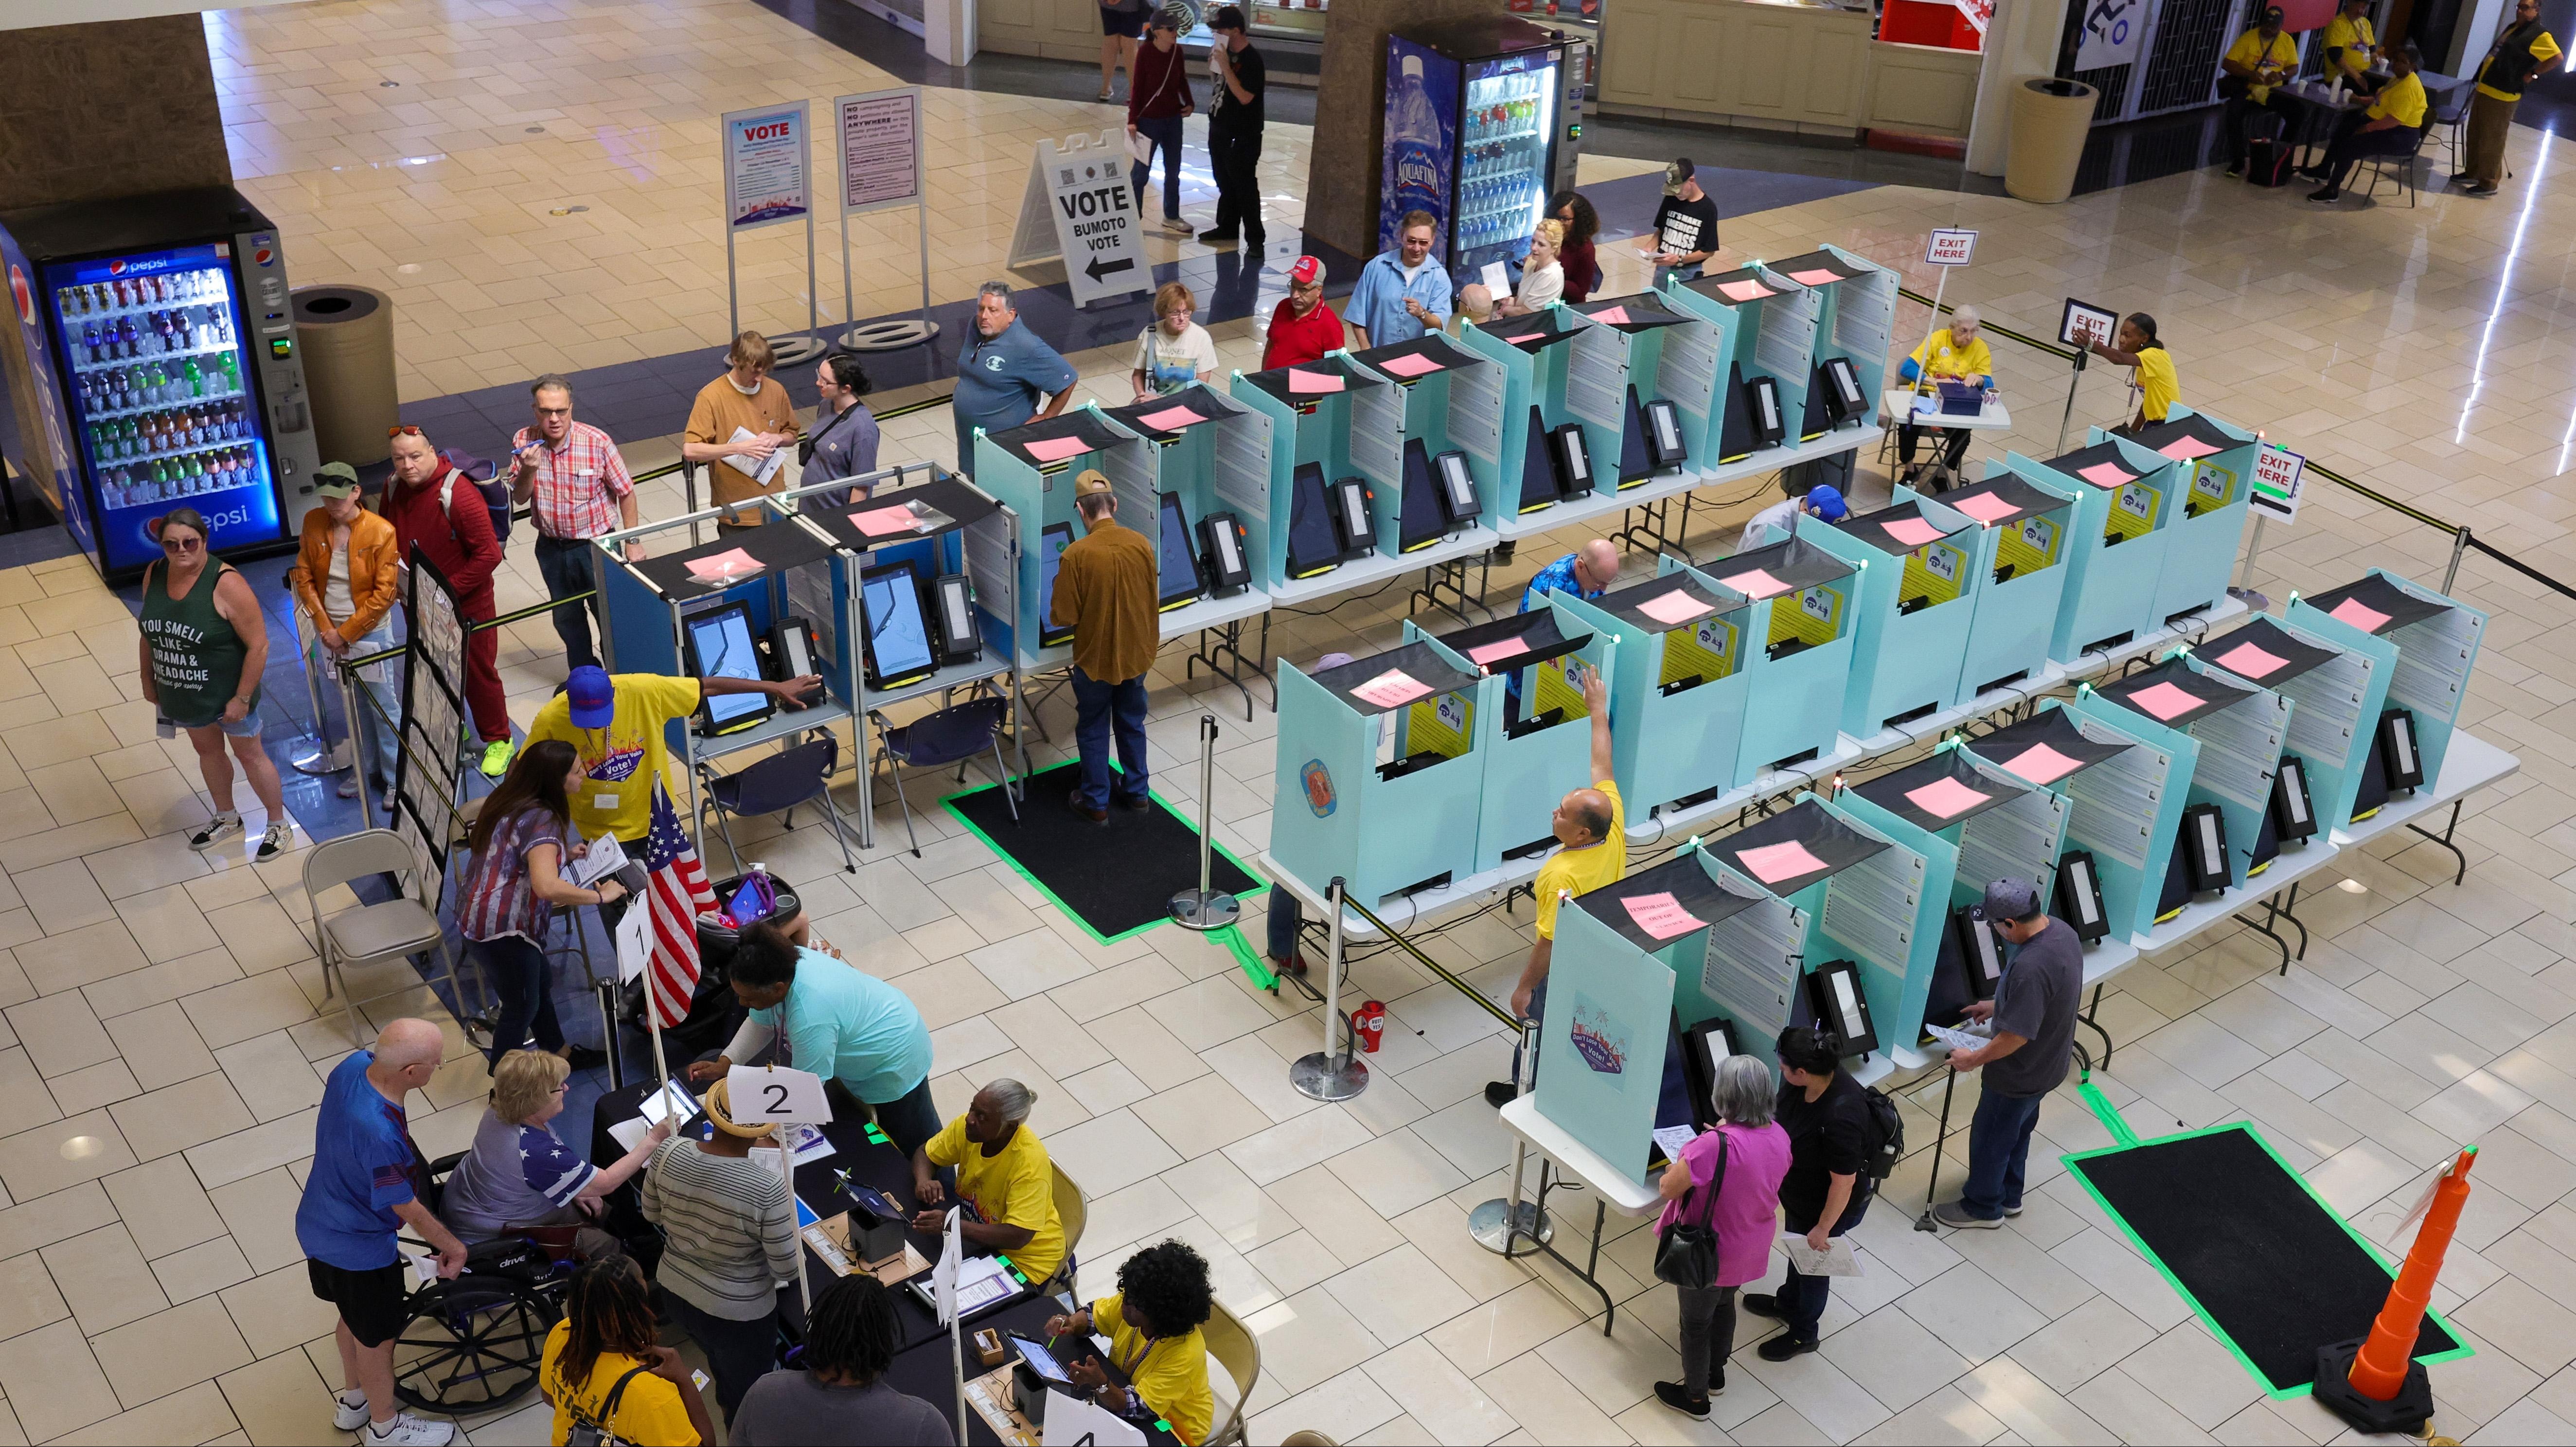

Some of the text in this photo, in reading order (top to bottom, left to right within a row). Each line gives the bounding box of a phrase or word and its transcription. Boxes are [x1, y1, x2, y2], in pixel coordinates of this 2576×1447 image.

[744, 122, 790, 141] VOTE
[848, 118, 891, 128] ANYWHERE
[1397, 162, 1439, 195] AQUAFINA
[1059, 185, 1130, 219] VOTE
[1073, 217, 1126, 237] BUMOTO
[1666, 217, 1700, 236] AMERICA
[1681, 214, 1703, 227] MAKE
[1087, 234, 1120, 251] VOTE
[1662, 226, 1697, 250] BADASS
[1938, 239, 1967, 248] EXIT
[1934, 249, 1966, 258] HERE
[130, 257, 168, 273] pepsi
[2076, 314, 2106, 331] EXIT
[2071, 326, 2105, 342] HRE
[35, 362, 87, 536] pepsi
[2259, 453, 2292, 472] EXIT
[2257, 467, 2290, 486] HERE
[200, 505, 248, 532] epsi
[142, 619, 203, 644] YOU SMELL
[153, 647, 198, 667] DRAMA &
[588, 765, 603, 777] Don't
[603, 758, 615, 768] Lose
[629, 750, 643, 758] Voice
[605, 759, 632, 775] Vote!
[1628, 901, 1675, 913] TEMPORARILY
[1586, 1036, 1598, 1046] Lose
[1598, 1042, 1609, 1055] Your
[1609, 1054, 1619, 1072] Voice
[1588, 1046, 1605, 1062] Vote!
[763, 1084, 793, 1114] 2
[499, 1255, 525, 1268] drive
